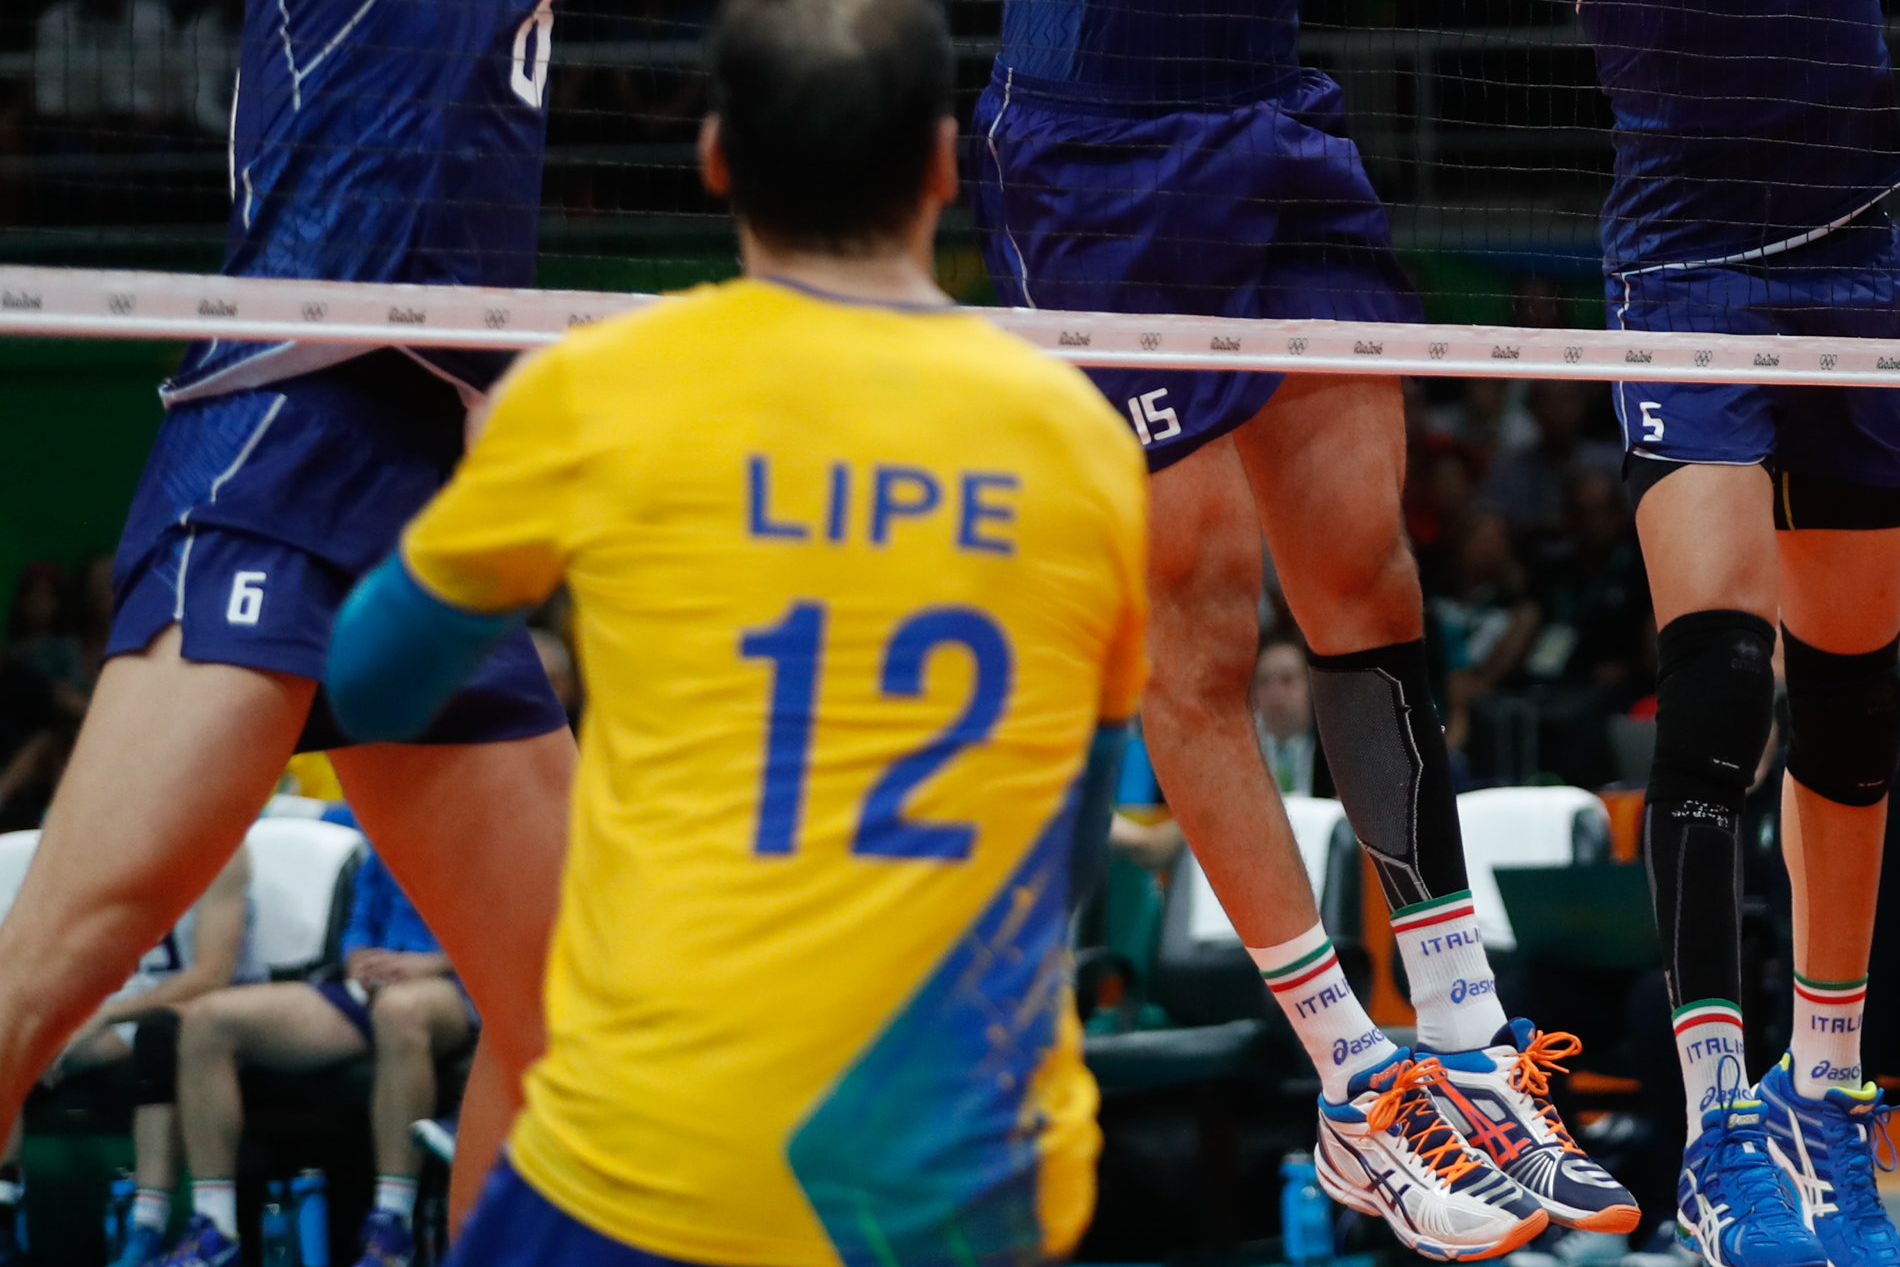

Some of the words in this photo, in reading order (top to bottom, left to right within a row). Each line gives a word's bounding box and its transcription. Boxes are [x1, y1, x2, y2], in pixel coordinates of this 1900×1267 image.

[1210, 336, 1241, 352] Rio2016
[1353, 340, 1383, 355] Rio2016
[1491, 345, 1520, 360] Rio2016
[1625, 349, 1653, 364] Rio2016
[1753, 353, 1780, 367] Rio2016
[1127, 387, 1182, 445] 15
[1639, 401, 1665, 442] 5
[747, 452, 1022, 556] LIPE
[226, 570, 267, 624] 6
[738, 598, 1018, 867] 12
[1294, 978, 1350, 1019] ITALI
[1811, 1014, 1863, 1033] ITALI
